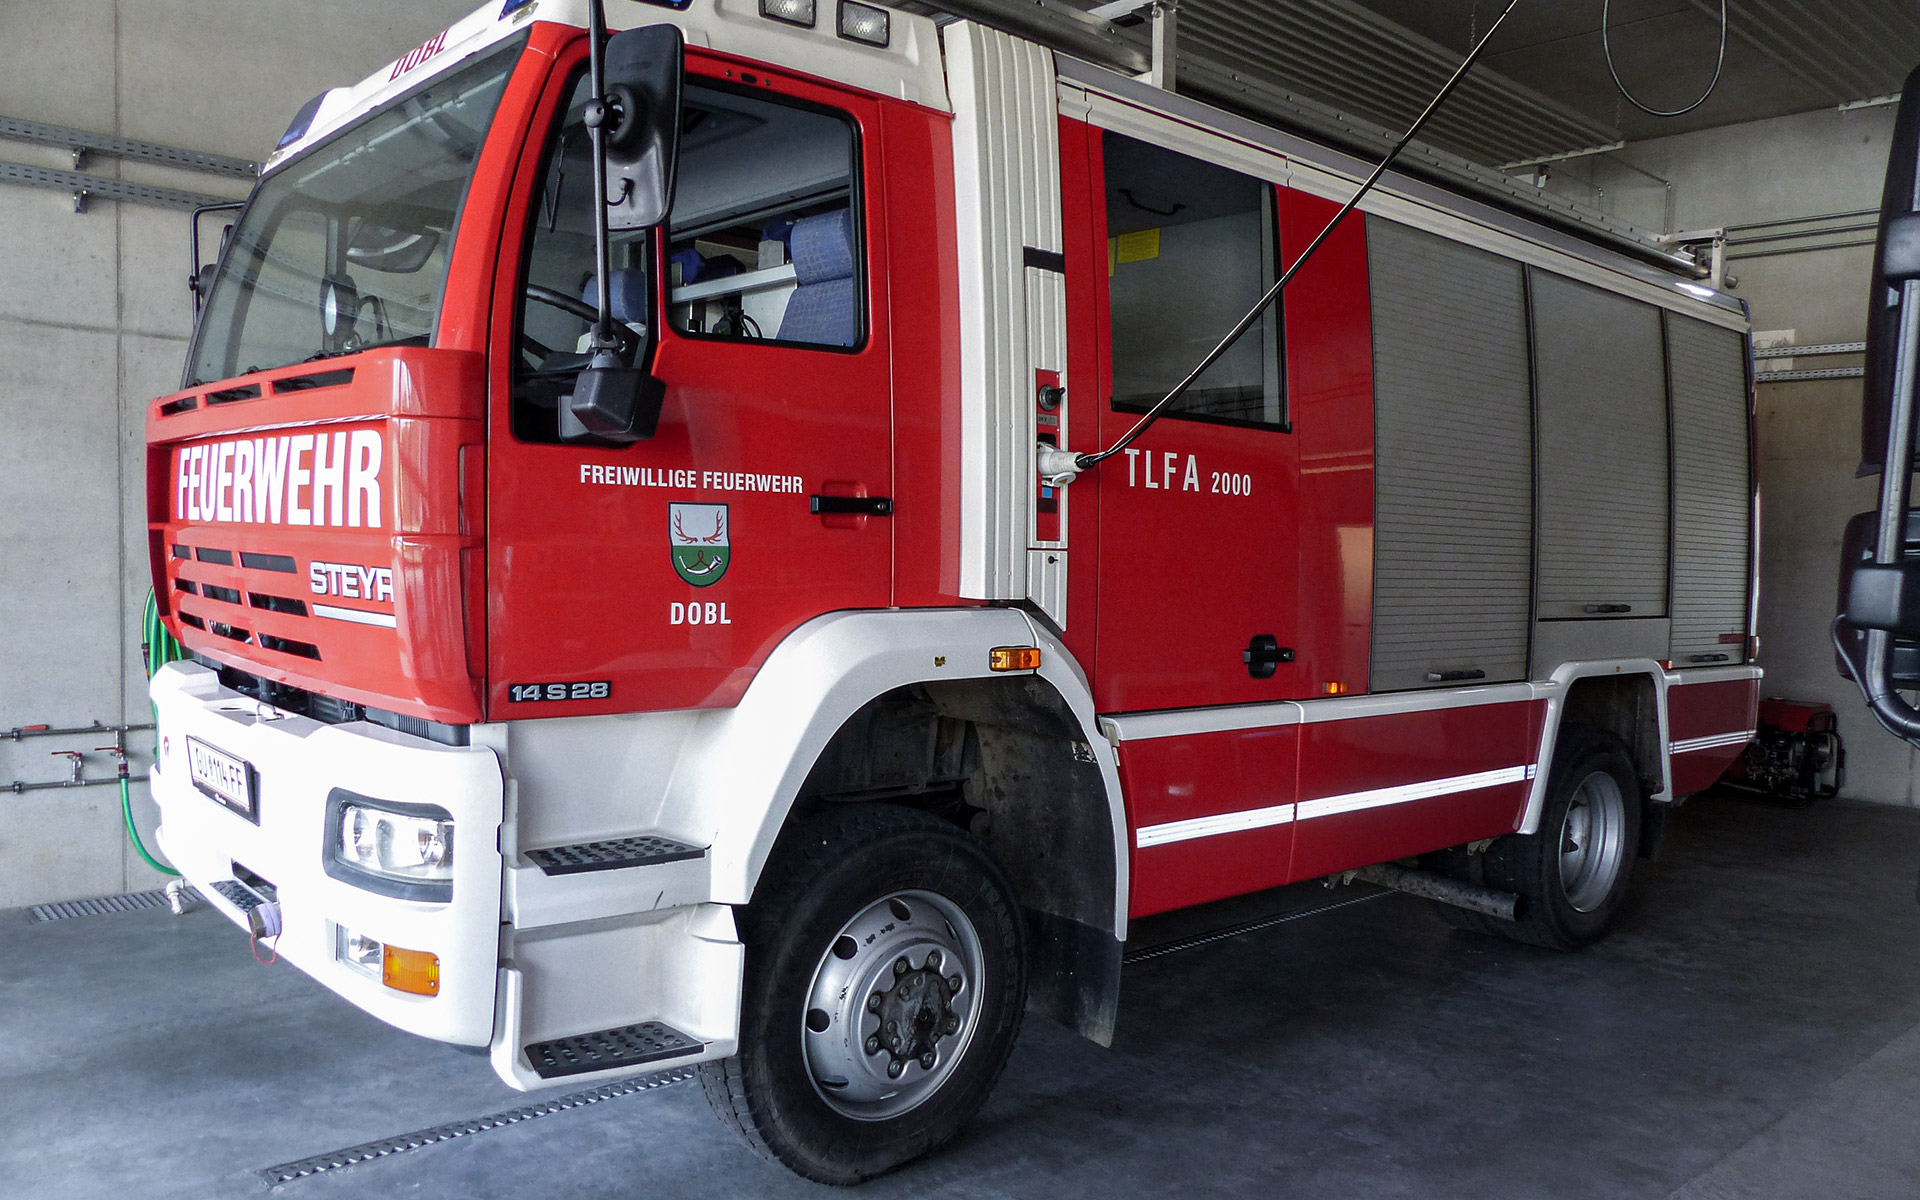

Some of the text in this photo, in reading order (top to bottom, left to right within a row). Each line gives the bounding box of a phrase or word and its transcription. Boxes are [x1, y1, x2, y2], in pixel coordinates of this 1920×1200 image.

[388, 27, 449, 82] DOBL
[177, 429, 382, 528] FEUERWEHR
[580, 464, 803, 494] FREIWILLIGE FEUERWEHR
[1125, 448, 1251, 497] TLFA 2000
[310, 561, 395, 603] STEYR
[670, 602, 732, 625] DOBL
[512, 682, 609, 702] 14 S 28
